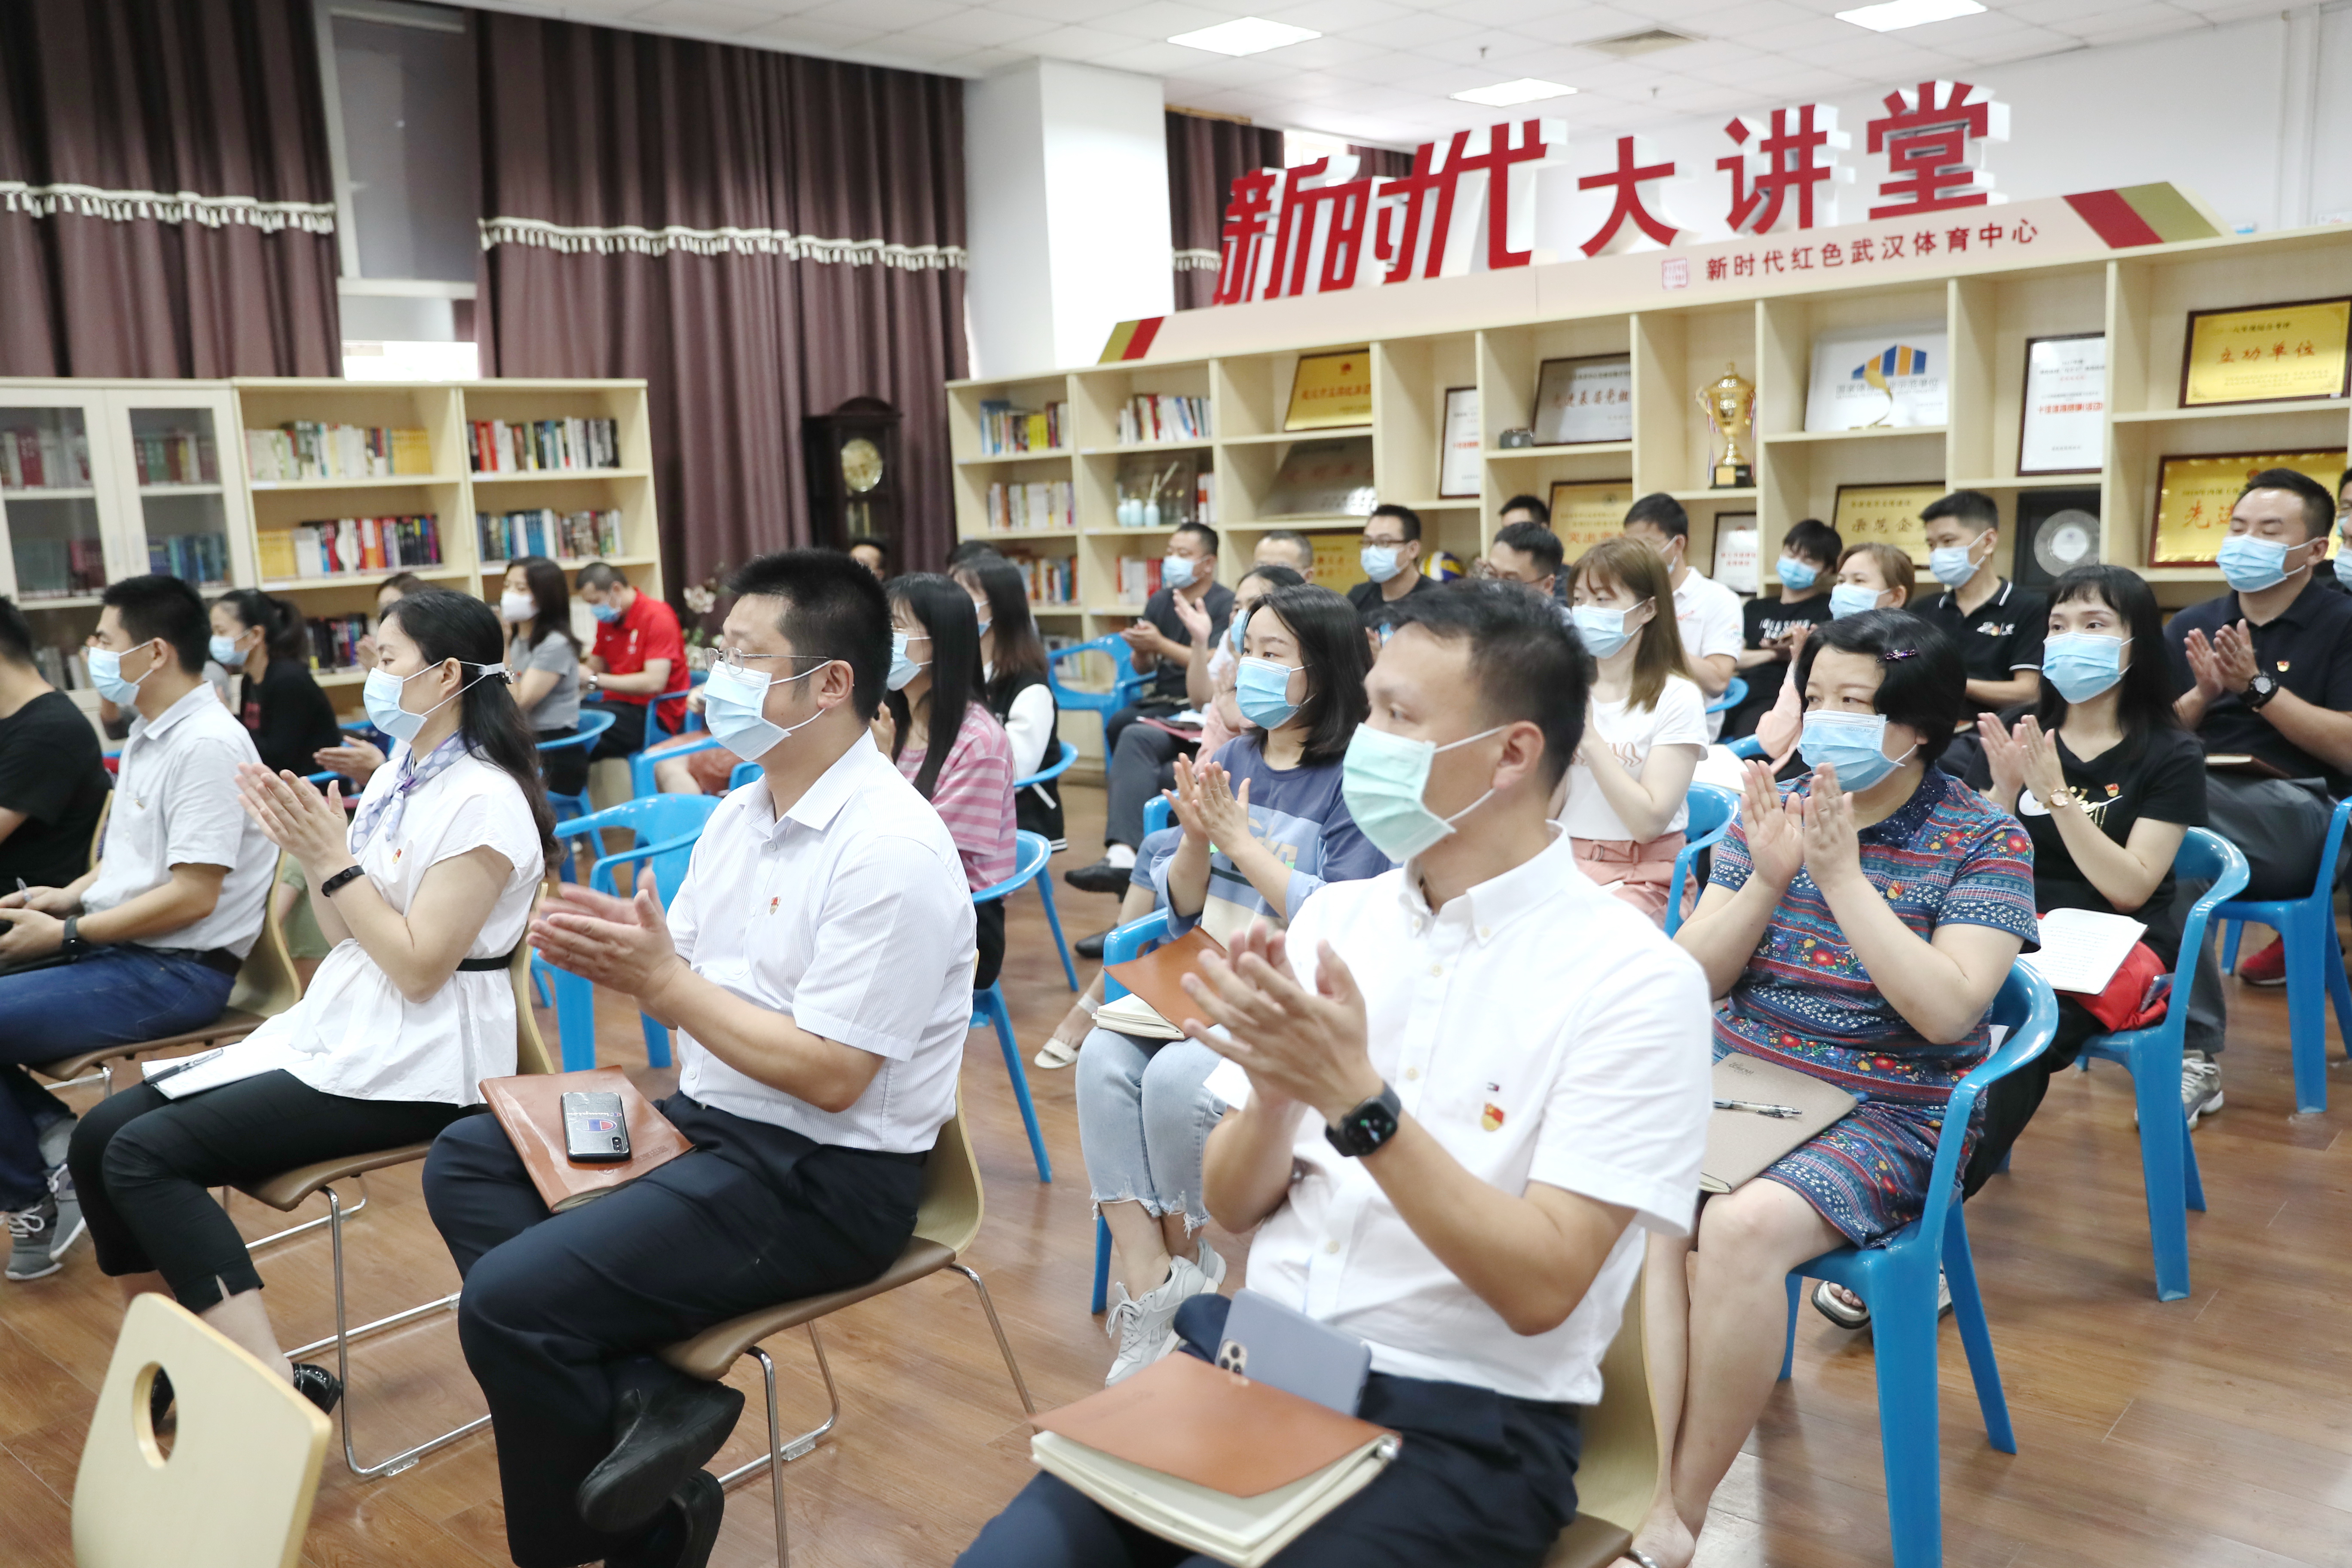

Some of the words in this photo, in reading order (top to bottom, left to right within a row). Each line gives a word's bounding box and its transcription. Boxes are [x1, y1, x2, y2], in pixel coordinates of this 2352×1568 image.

[1706, 218, 2039, 281] 新时代红色武汉体育中心
[2217, 341, 2315, 364] 立功单位
[1851, 517, 1925, 533] 示范企
